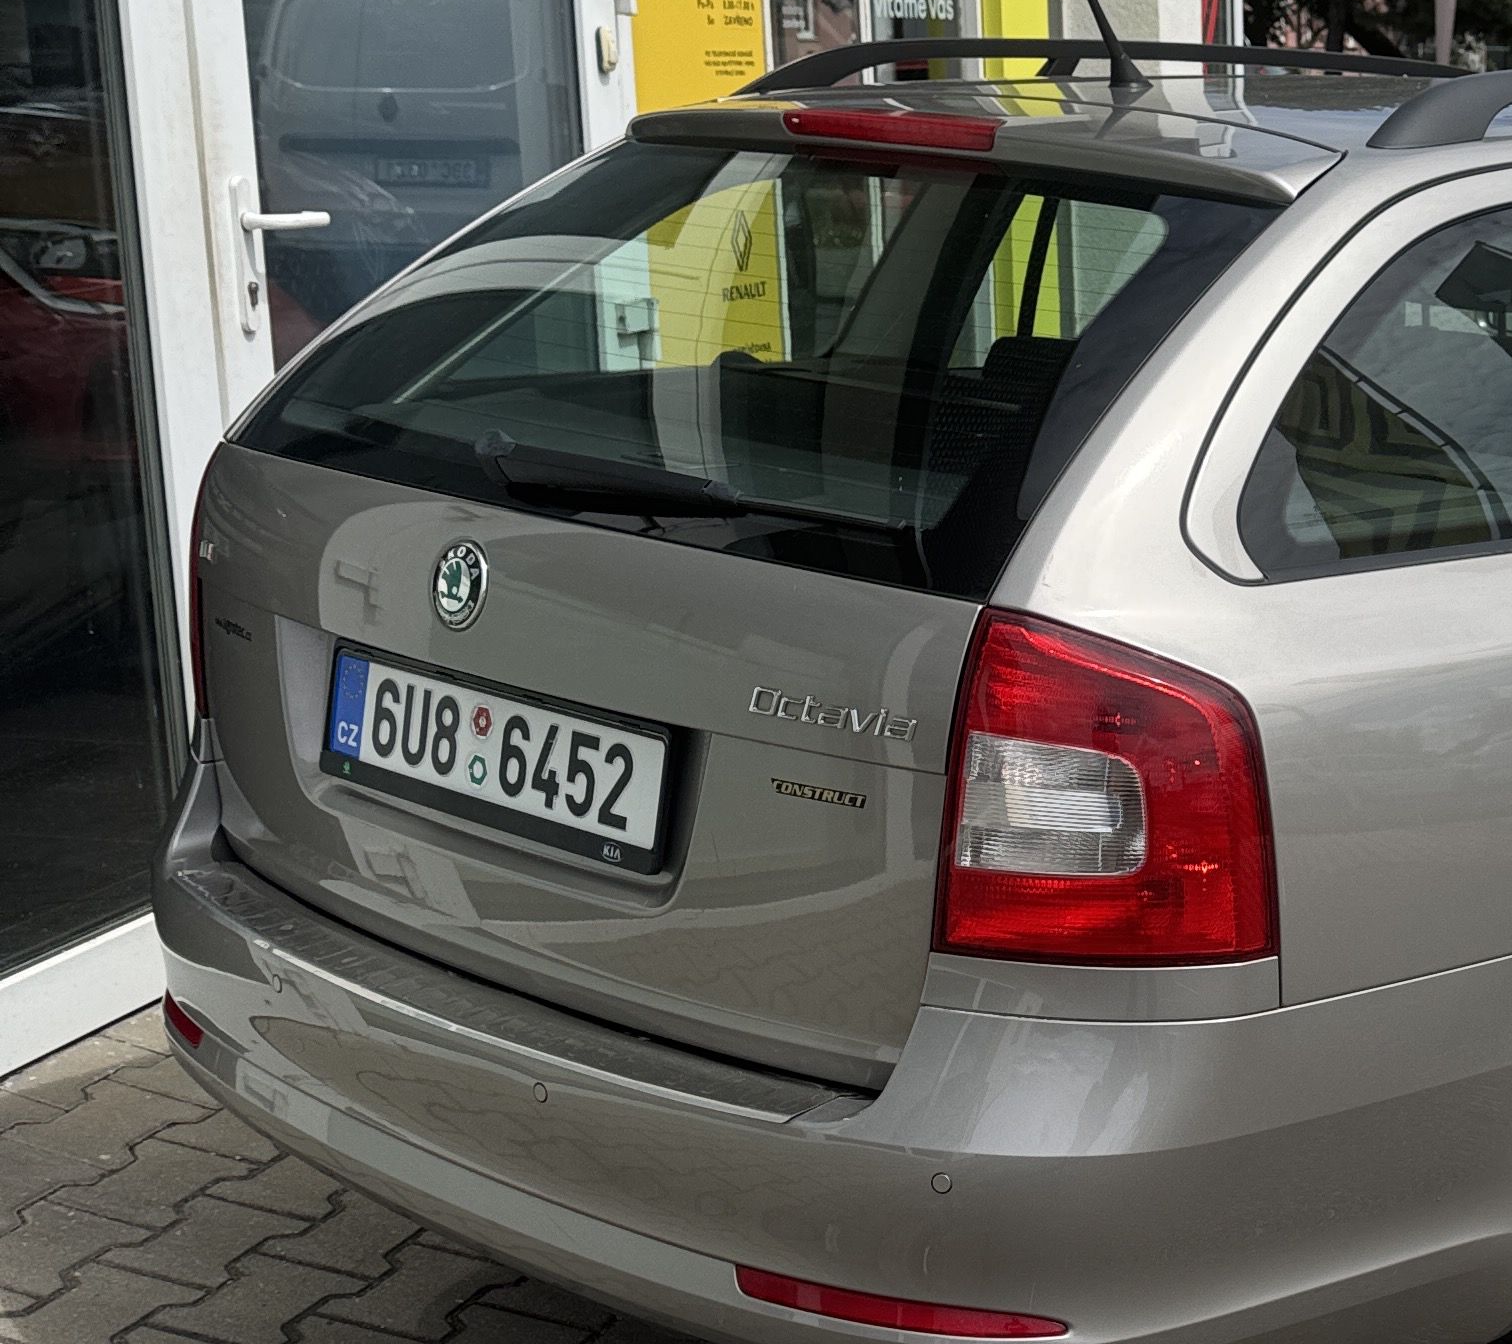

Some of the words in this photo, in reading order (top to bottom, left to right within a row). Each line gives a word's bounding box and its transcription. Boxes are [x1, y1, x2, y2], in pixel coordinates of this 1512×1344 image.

[722, 281, 767, 302] RENAULT
[749, 686, 918, 742] Octavia
[336, 720, 359, 748] CZ
[371, 677, 461, 776] 6U8
[498, 714, 634, 832] 6452
[772, 779, 866, 808] CONSTRUCT
[602, 844, 622, 861] KIA
